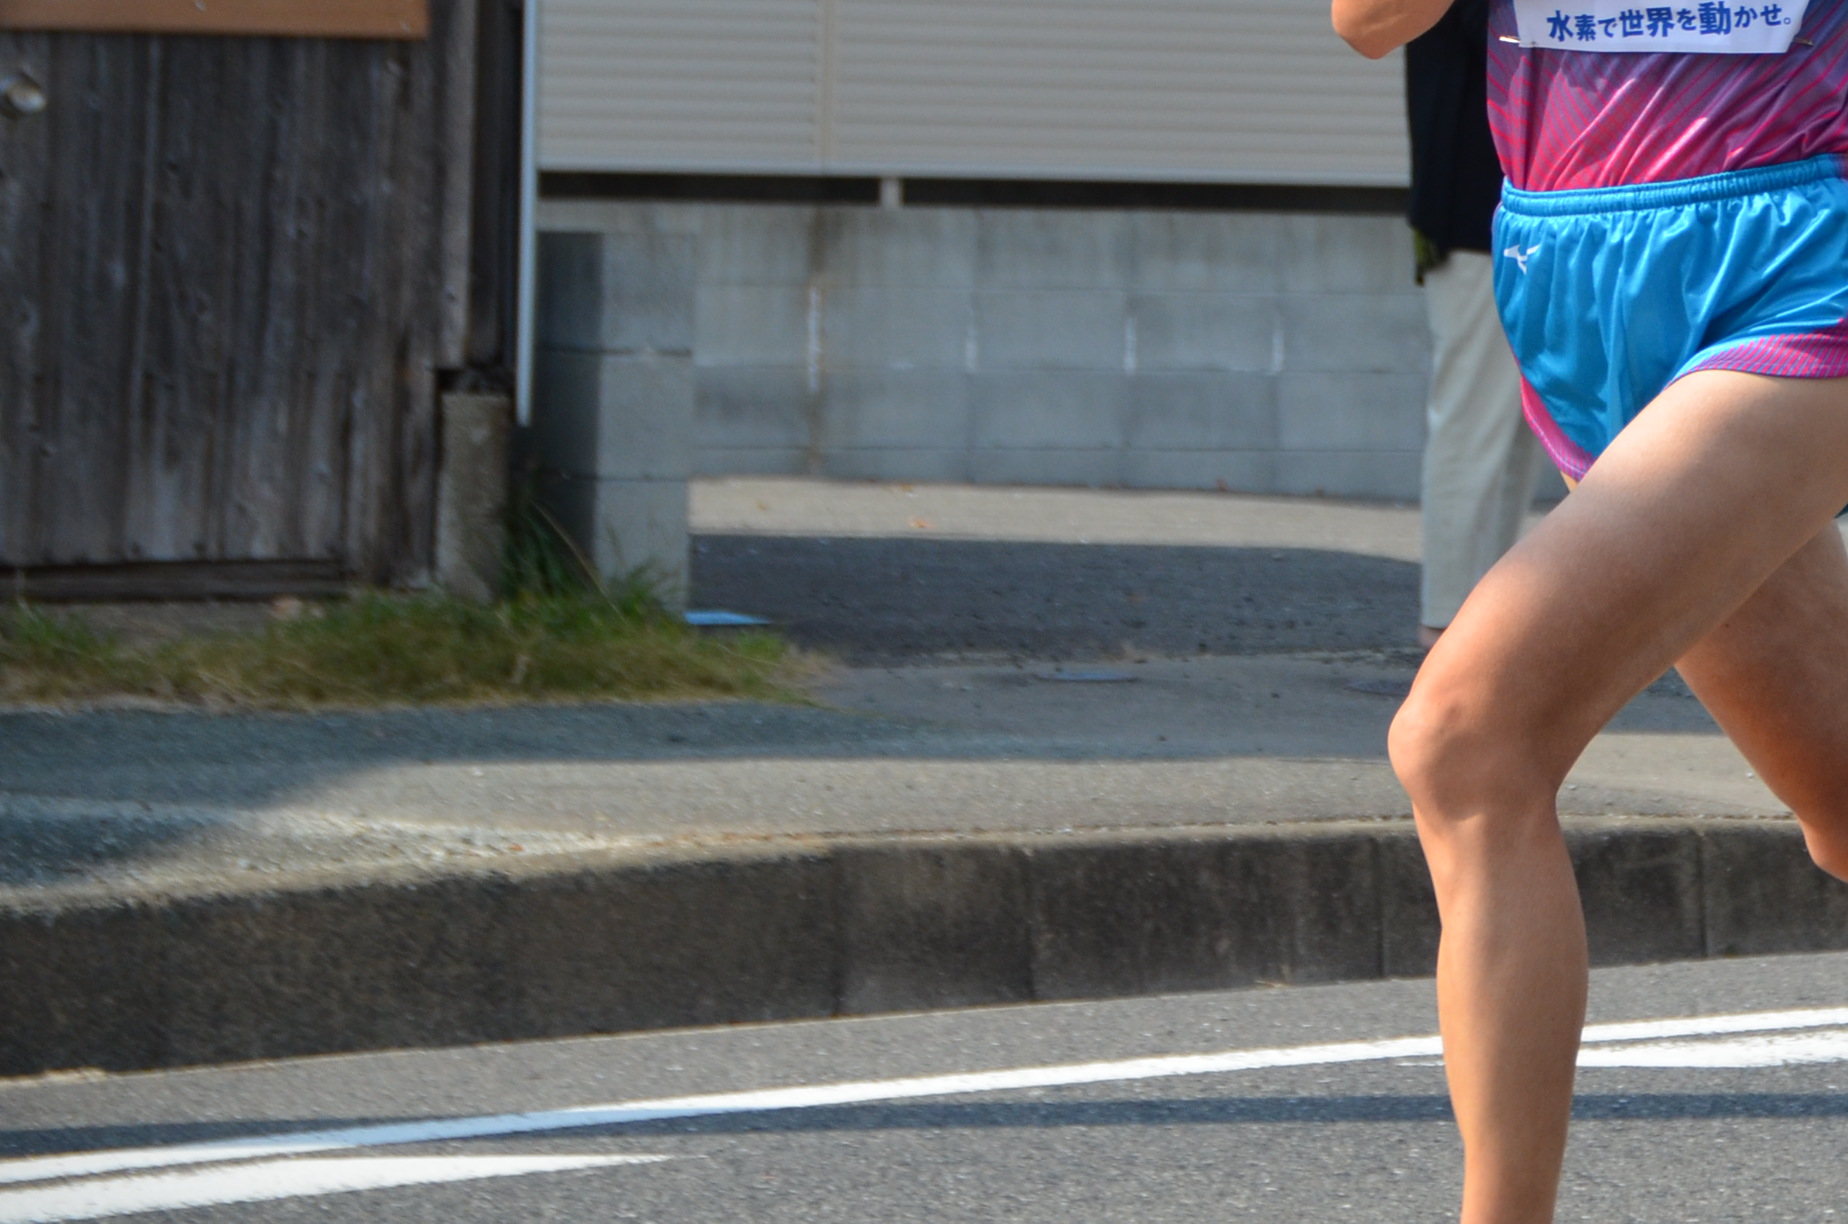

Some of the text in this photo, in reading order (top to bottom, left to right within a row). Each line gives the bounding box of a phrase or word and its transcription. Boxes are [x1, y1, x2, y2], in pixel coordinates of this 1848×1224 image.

[1545, 0, 1793, 44] 水素で世界を動かせ。
